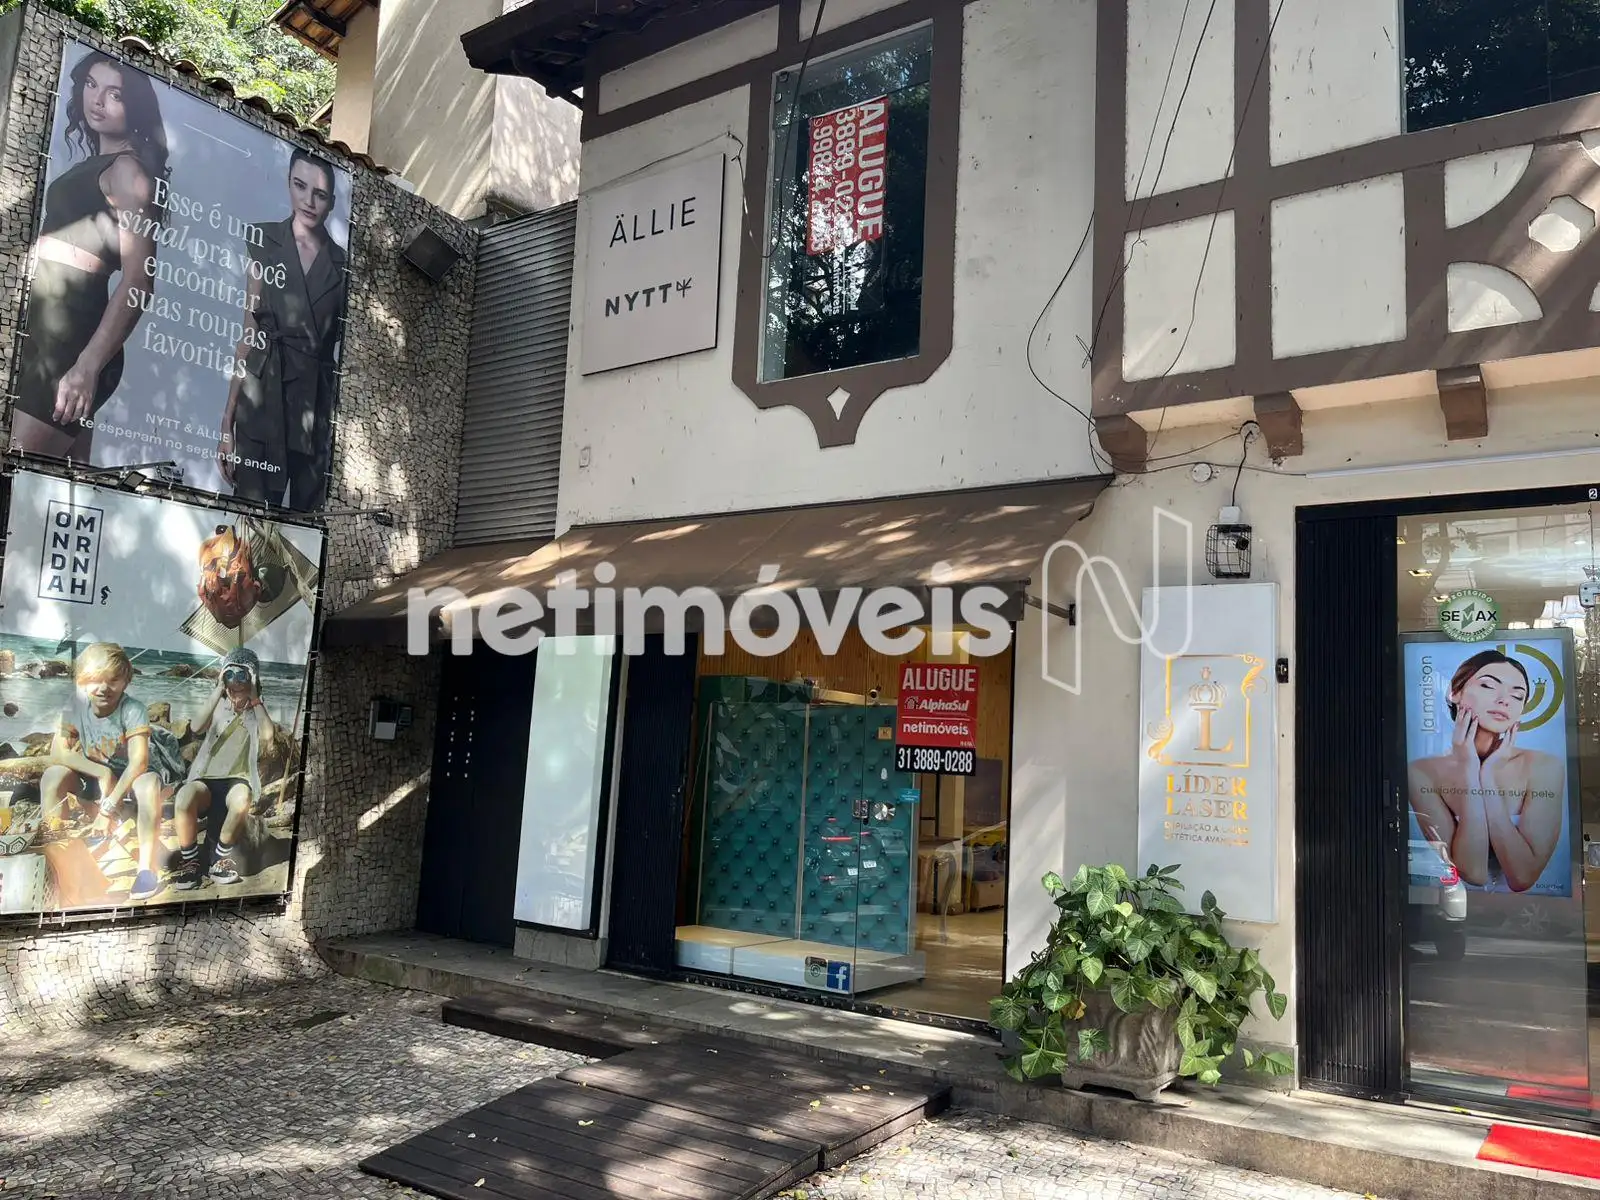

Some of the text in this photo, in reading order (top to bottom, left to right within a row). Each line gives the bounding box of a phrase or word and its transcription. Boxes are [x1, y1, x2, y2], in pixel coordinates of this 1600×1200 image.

[858, 103, 885, 241] ALUGUE
[152, 176, 264, 248] Esse é um
[609, 196, 696, 248] ÄLLIE
[118, 208, 287, 289] sinal pra você
[144, 255, 261, 313] encontrar
[605, 282, 673, 317] NYTT
[127, 287, 267, 350] suas roupas
[142, 321, 247, 379] favoritas
[145, 412, 180, 431] NYTT
[184, 422, 193, 433] &
[79, 416, 281, 473] te esperam no segundo andar
[1441, 610, 1497, 622] SEMAX
[902, 667, 976, 692] ALUGUE
[1419, 655, 1435, 732] la maison
[919, 699, 969, 713] AlphaSul
[903, 721, 969, 736] netimóveis
[898, 747, 973, 773] 31 3889-0288
[1166, 768, 1248, 798] LÍDER
[1471, 787, 1496, 797] com
[1498, 788, 1505, 797] a
[1508, 788, 1528, 798] sua
[1531, 789, 1555, 802] pele
[1166, 797, 1248, 820] LASER
